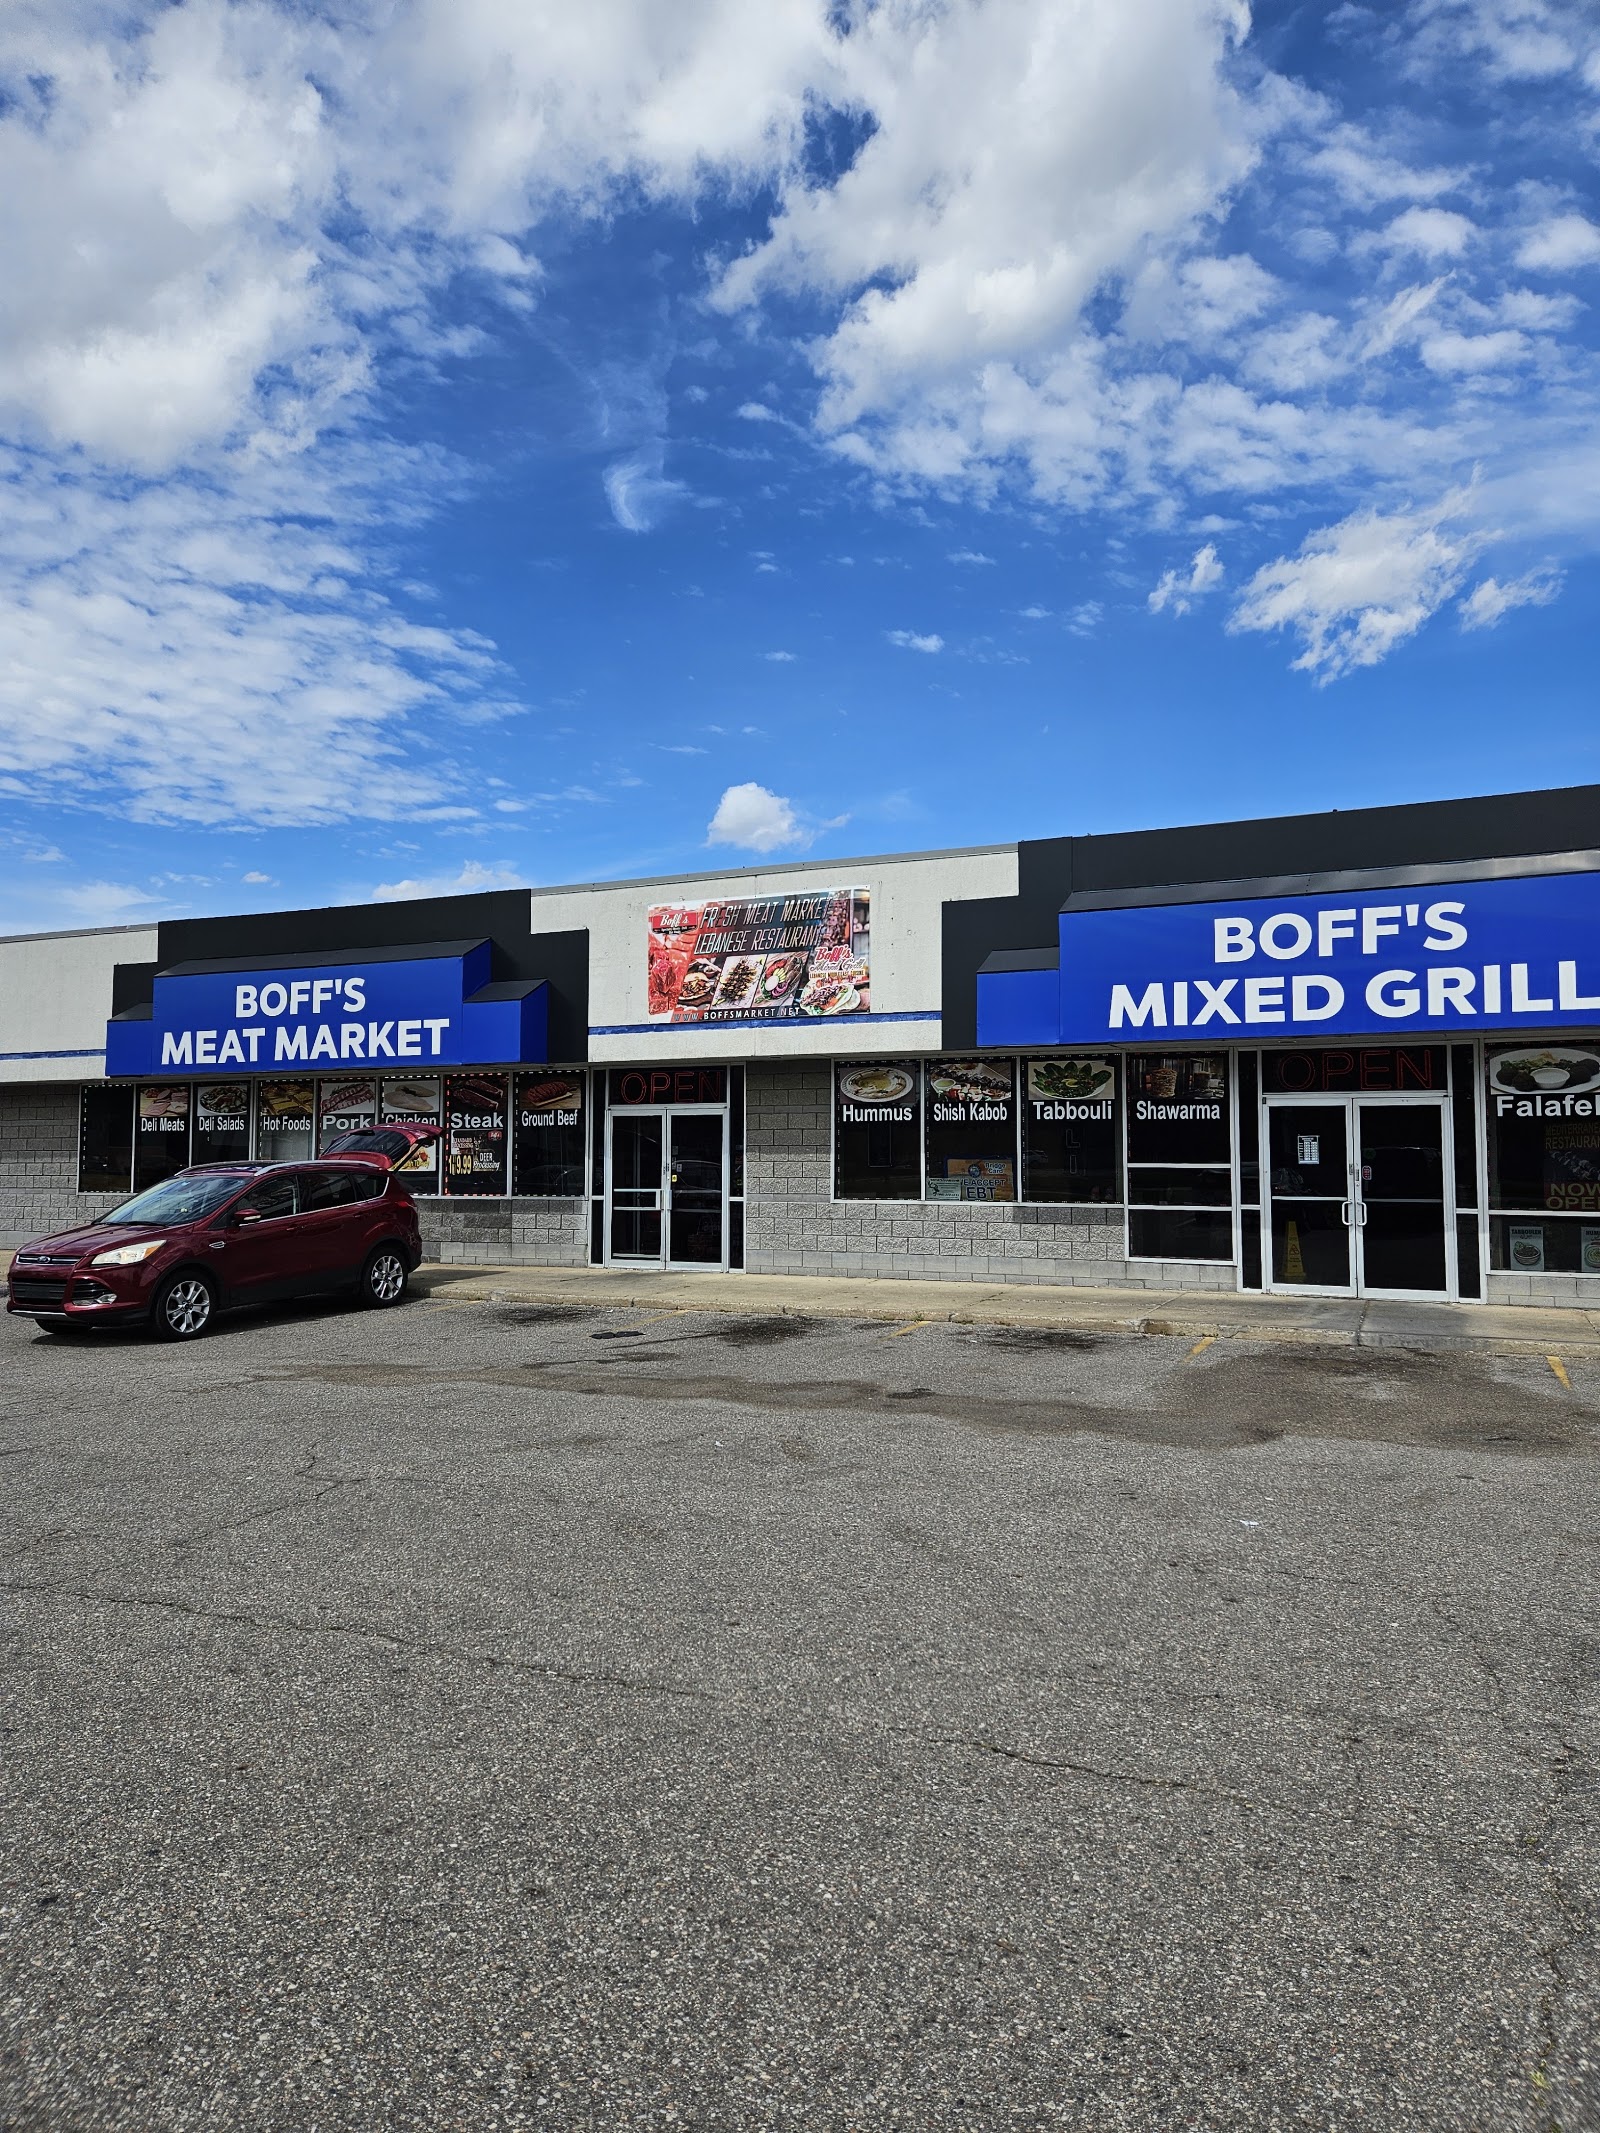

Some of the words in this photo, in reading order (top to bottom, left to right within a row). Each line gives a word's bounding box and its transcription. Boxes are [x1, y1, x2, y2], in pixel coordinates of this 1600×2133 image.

[660, 912, 690, 927] Boff's
[700, 905, 743, 929] FRESH
[744, 902, 779, 926] MEAT
[780, 898, 835, 922] MARKET
[694, 930, 750, 955] LEBANESE
[751, 923, 824, 951] RESTAURANT
[1214, 901, 1468, 963] BOFF'S
[815, 944, 853, 962] Boff's
[235, 978, 366, 1018] BOFF'S
[1108, 974, 1345, 1028] MIXED
[1365, 960, 1600, 1019] GRILL
[161, 1027, 265, 1065] MEAT
[274, 1018, 450, 1061] MARKET
[1280, 1050, 1432, 1090] OPEN
[621, 1072, 721, 1104] OPEN
[843, 1104, 913, 1122] Hummus
[934, 1103, 966, 1121] Shish
[969, 1102, 1008, 1121] Kabob
[1033, 1101, 1112, 1120] Tabbouli
[1136, 1100, 1220, 1120] Shawarma
[1497, 1094, 1600, 1117] Falafel
[141, 1118, 157, 1132] Deli
[160, 1117, 185, 1132] Meats
[199, 1116, 215, 1132] Deli
[217, 1116, 245, 1131] Salads
[263, 1116, 280, 1131] Hot
[282, 1116, 311, 1131] Foods
[323, 1114, 372, 1130] Pork
[451, 1112, 504, 1129] Steak
[522, 1111, 554, 1127] Ground
[557, 1109, 578, 1126] Beef
[1545, 1121, 1600, 1136] MEDITERRANE
[473, 1160, 501, 1171] Processing
[479, 1152, 493, 1162] DEER
[972, 1179, 1006, 1187] ACCEPT
[967, 1187, 997, 1199] EBT
